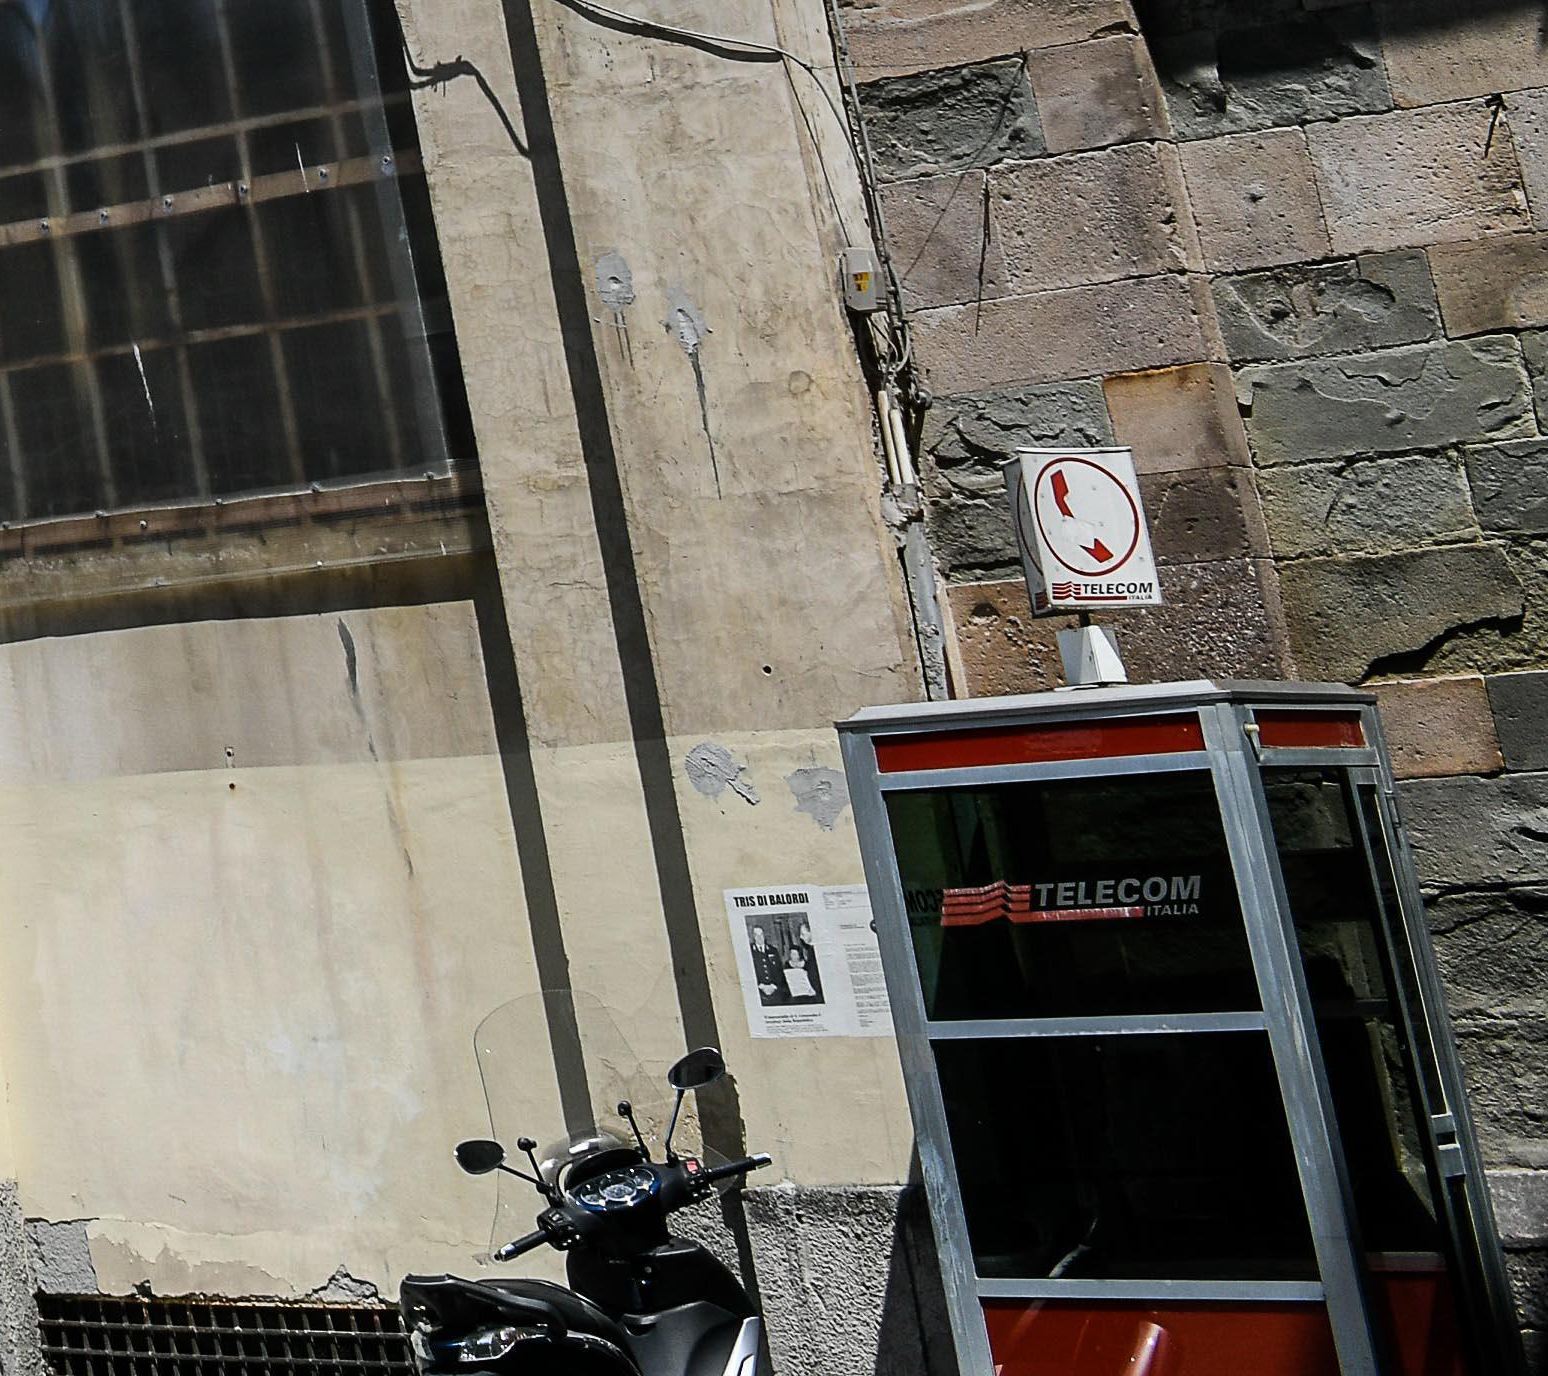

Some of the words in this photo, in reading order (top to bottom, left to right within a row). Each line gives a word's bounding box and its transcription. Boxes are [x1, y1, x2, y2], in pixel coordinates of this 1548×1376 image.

[1082, 582, 1153, 595] TELECOM
[1034, 875, 1201, 907] TELECOM
[733, 896, 756, 908] TRIS
[756, 895, 768, 906] DI
[769, 892, 809, 905] BALORDI
[1146, 903, 1200, 917] ITALIA
